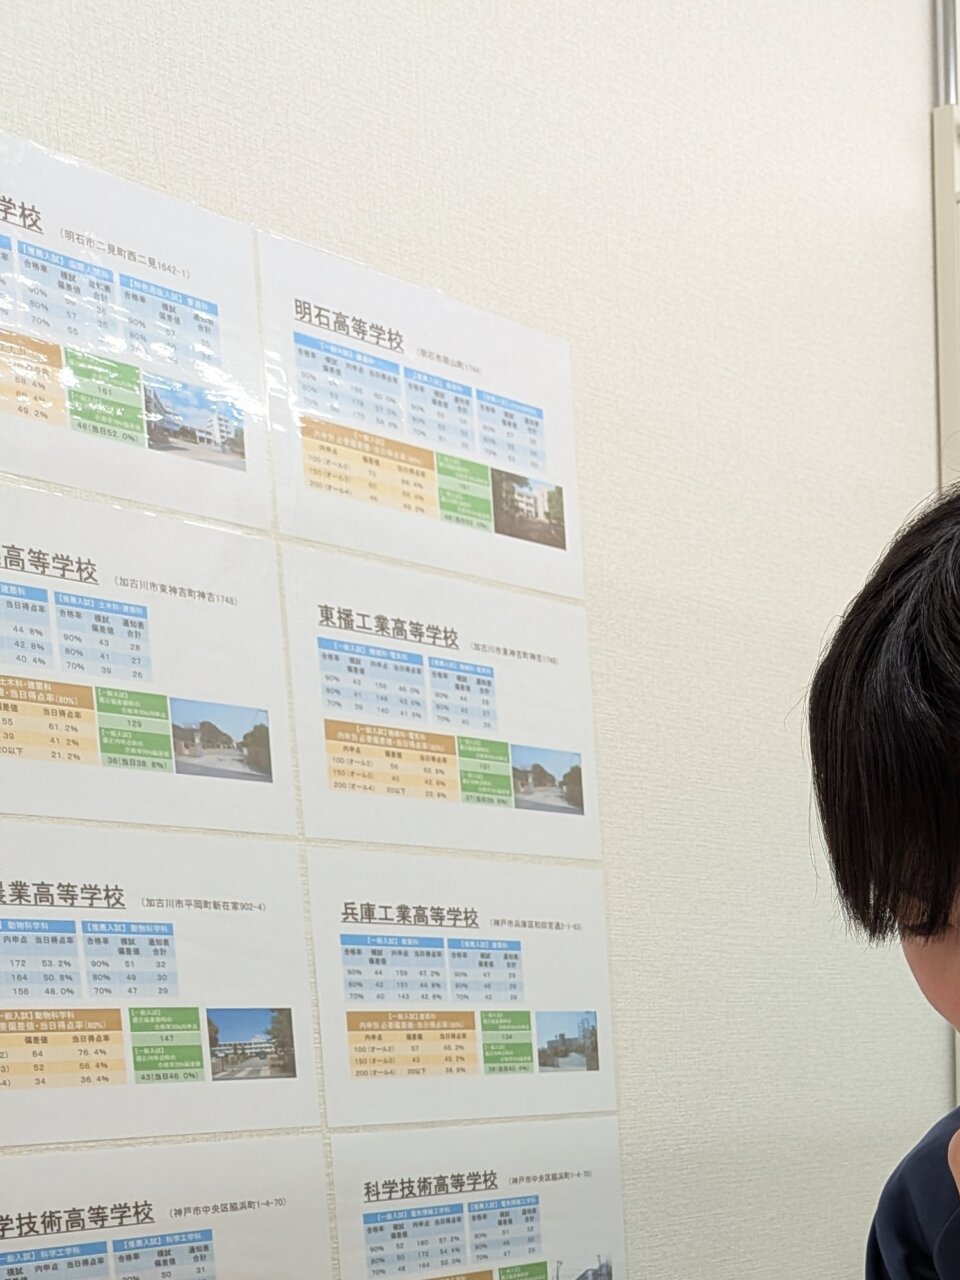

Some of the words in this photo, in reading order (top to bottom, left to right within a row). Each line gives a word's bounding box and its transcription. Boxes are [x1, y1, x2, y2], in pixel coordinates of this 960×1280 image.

[0, 195, 43, 233] 学校
[294, 299, 404, 352] 明石高等学校
[2, 545, 98, 583] 高等学校
[59, 609, 82, 619] 合格率
[318, 604, 459, 650] 東播工業高等学校
[63, 634, 82, 643] 90%
[98, 639, 110, 647] 43
[131, 657, 141, 665] 27
[66, 661, 85, 671] 70%
[43, 709, 82, 719] 当日得点率
[127, 719, 142, 728] 129
[3, 732, 15, 740] 39
[51, 751, 80, 761] 21.2%
[341, 902, 479, 928] 兵庫工業高等学校
[87, 937, 109, 945] 合格率
[120, 937, 136, 946] 模試
[153, 948, 167, 956] 合計
[10, 959, 26, 967] 172
[91, 960, 109, 968] 90%
[125, 960, 135, 968] 51
[93, 987, 112, 995] 70%
[128, 987, 137, 995] 47
[158, 987, 168, 995] 29
[24, 1036, 48, 1044] 偏差値
[72, 1035, 110, 1044] 当日得点率
[364, 1170, 498, 1203] 科学技術高等学校
[169, 1198, 287, 1219] （神戸市中央区脇浜町1-4-70）
[0, 1200, 154, 1238] 学技術高等学校
[118, 1253, 140, 1262] 合格率
[157, 1249, 172, 1257] 模試
[67, 1257, 104, 1269] 当日得点率
[154, 1258, 176, 1267] 偏差値
[7, 1267, 23, 1276] 模試
[35, 1263, 58, 1272] 内申点
